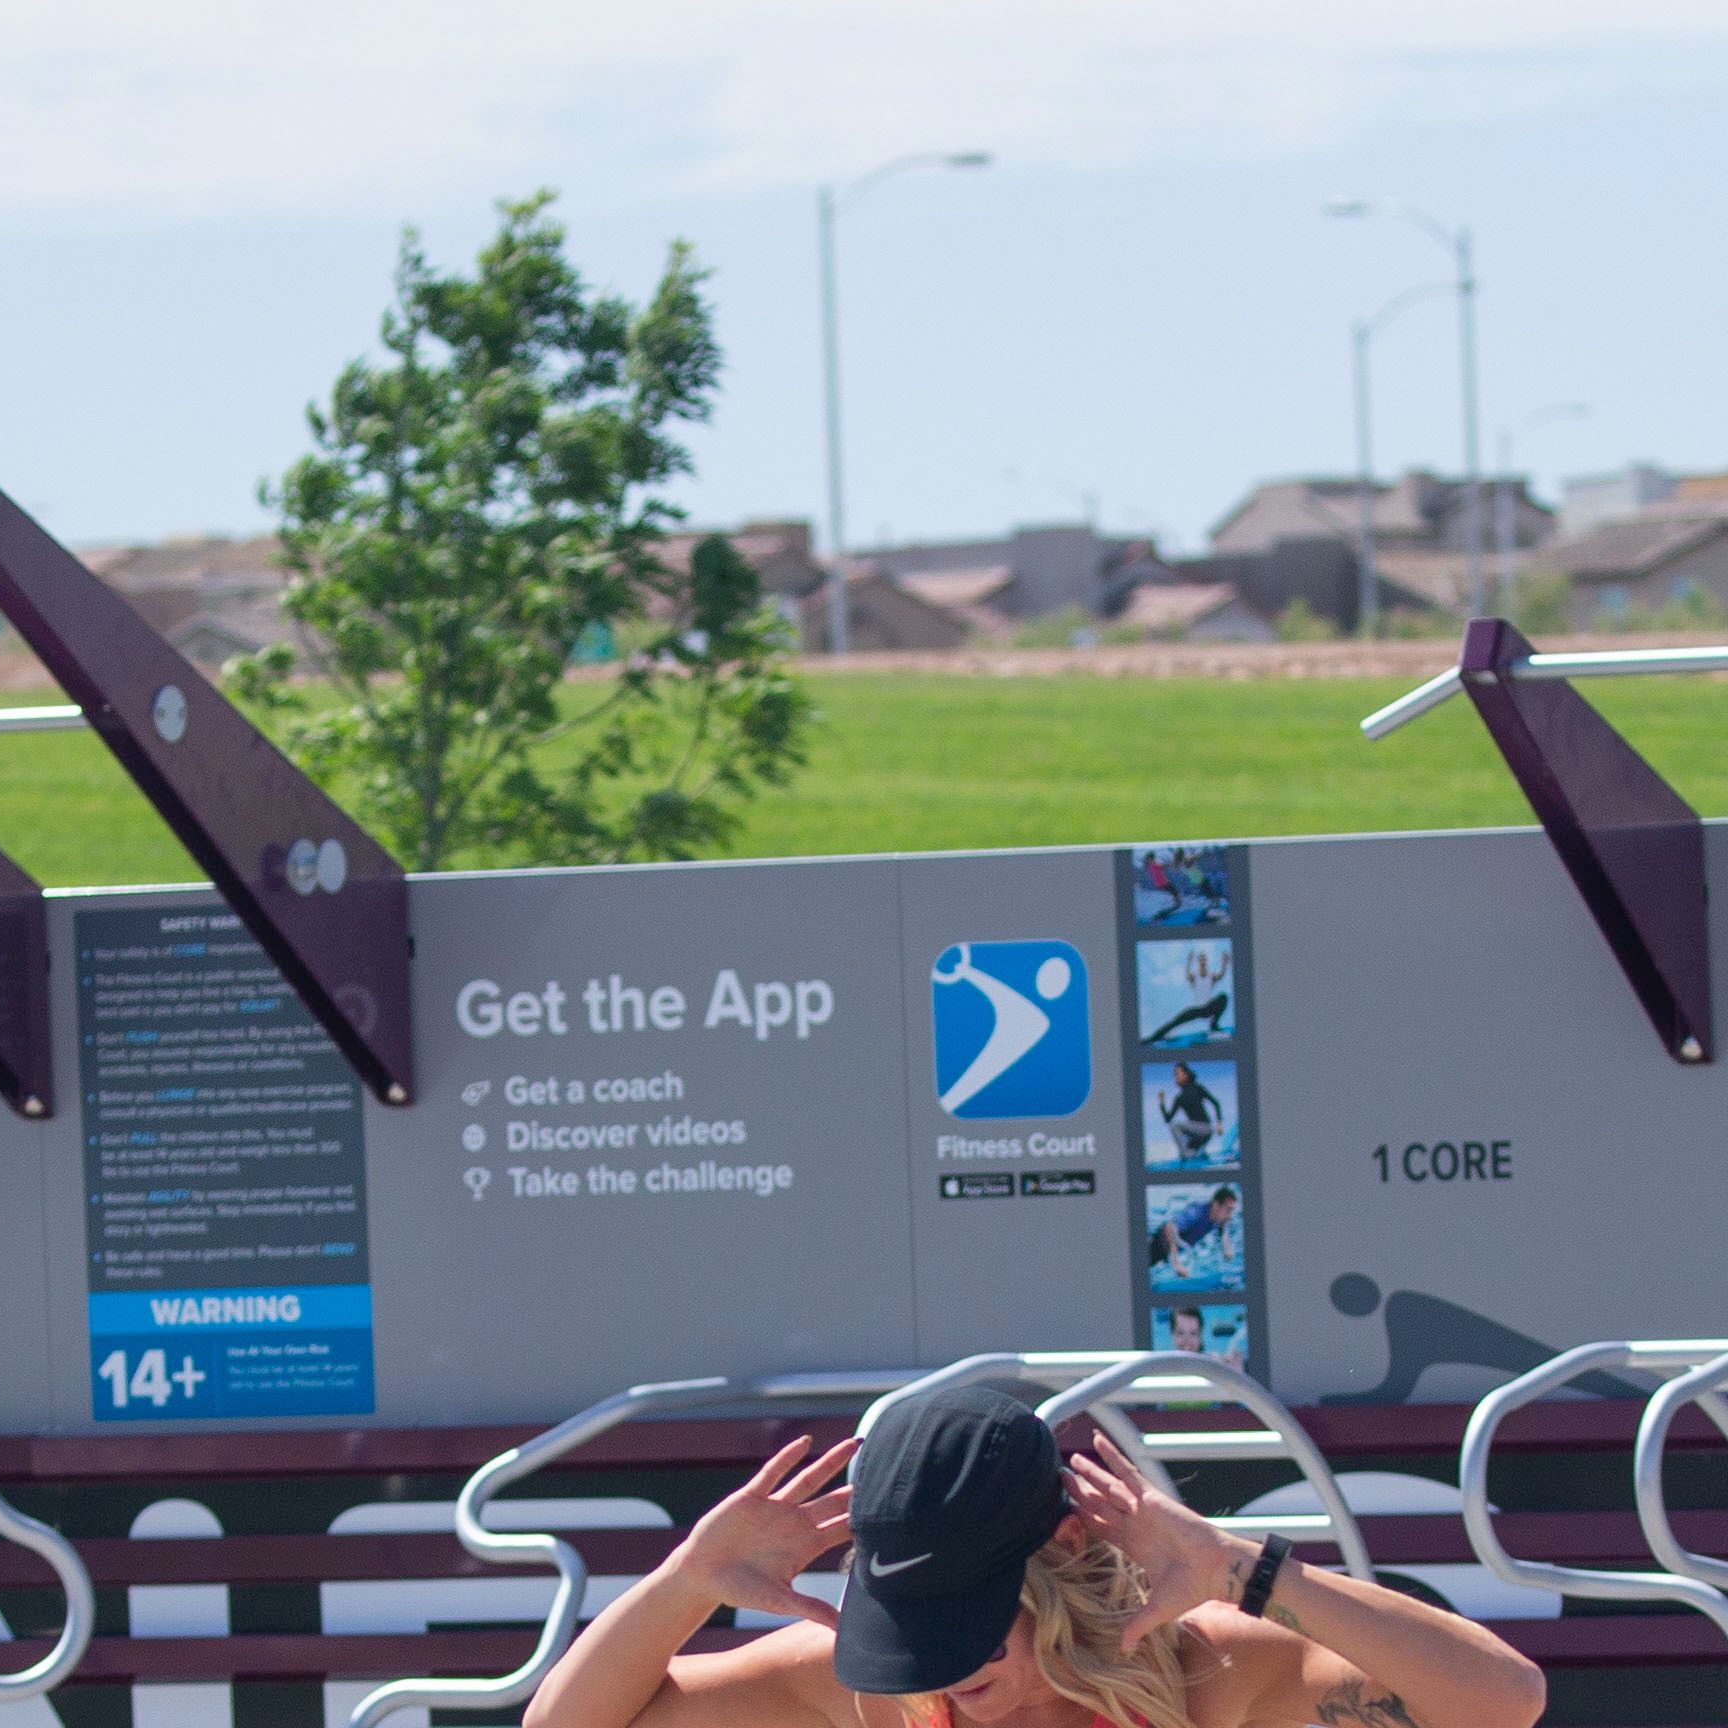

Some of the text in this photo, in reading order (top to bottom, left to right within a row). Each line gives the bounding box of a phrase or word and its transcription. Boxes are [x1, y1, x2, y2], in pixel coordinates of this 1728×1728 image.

[456, 969, 834, 1041] Get the App
[505, 1071, 683, 1106] Get a coach
[506, 1115, 746, 1151] Discover videos
[937, 1131, 1095, 1159] Fitness Court
[507, 1159, 793, 1197] Take the challenge
[1372, 1140, 1513, 1183] 1 CORE
[150, 1294, 302, 1326] WARNING
[98, 1347, 206, 1411] 14+
